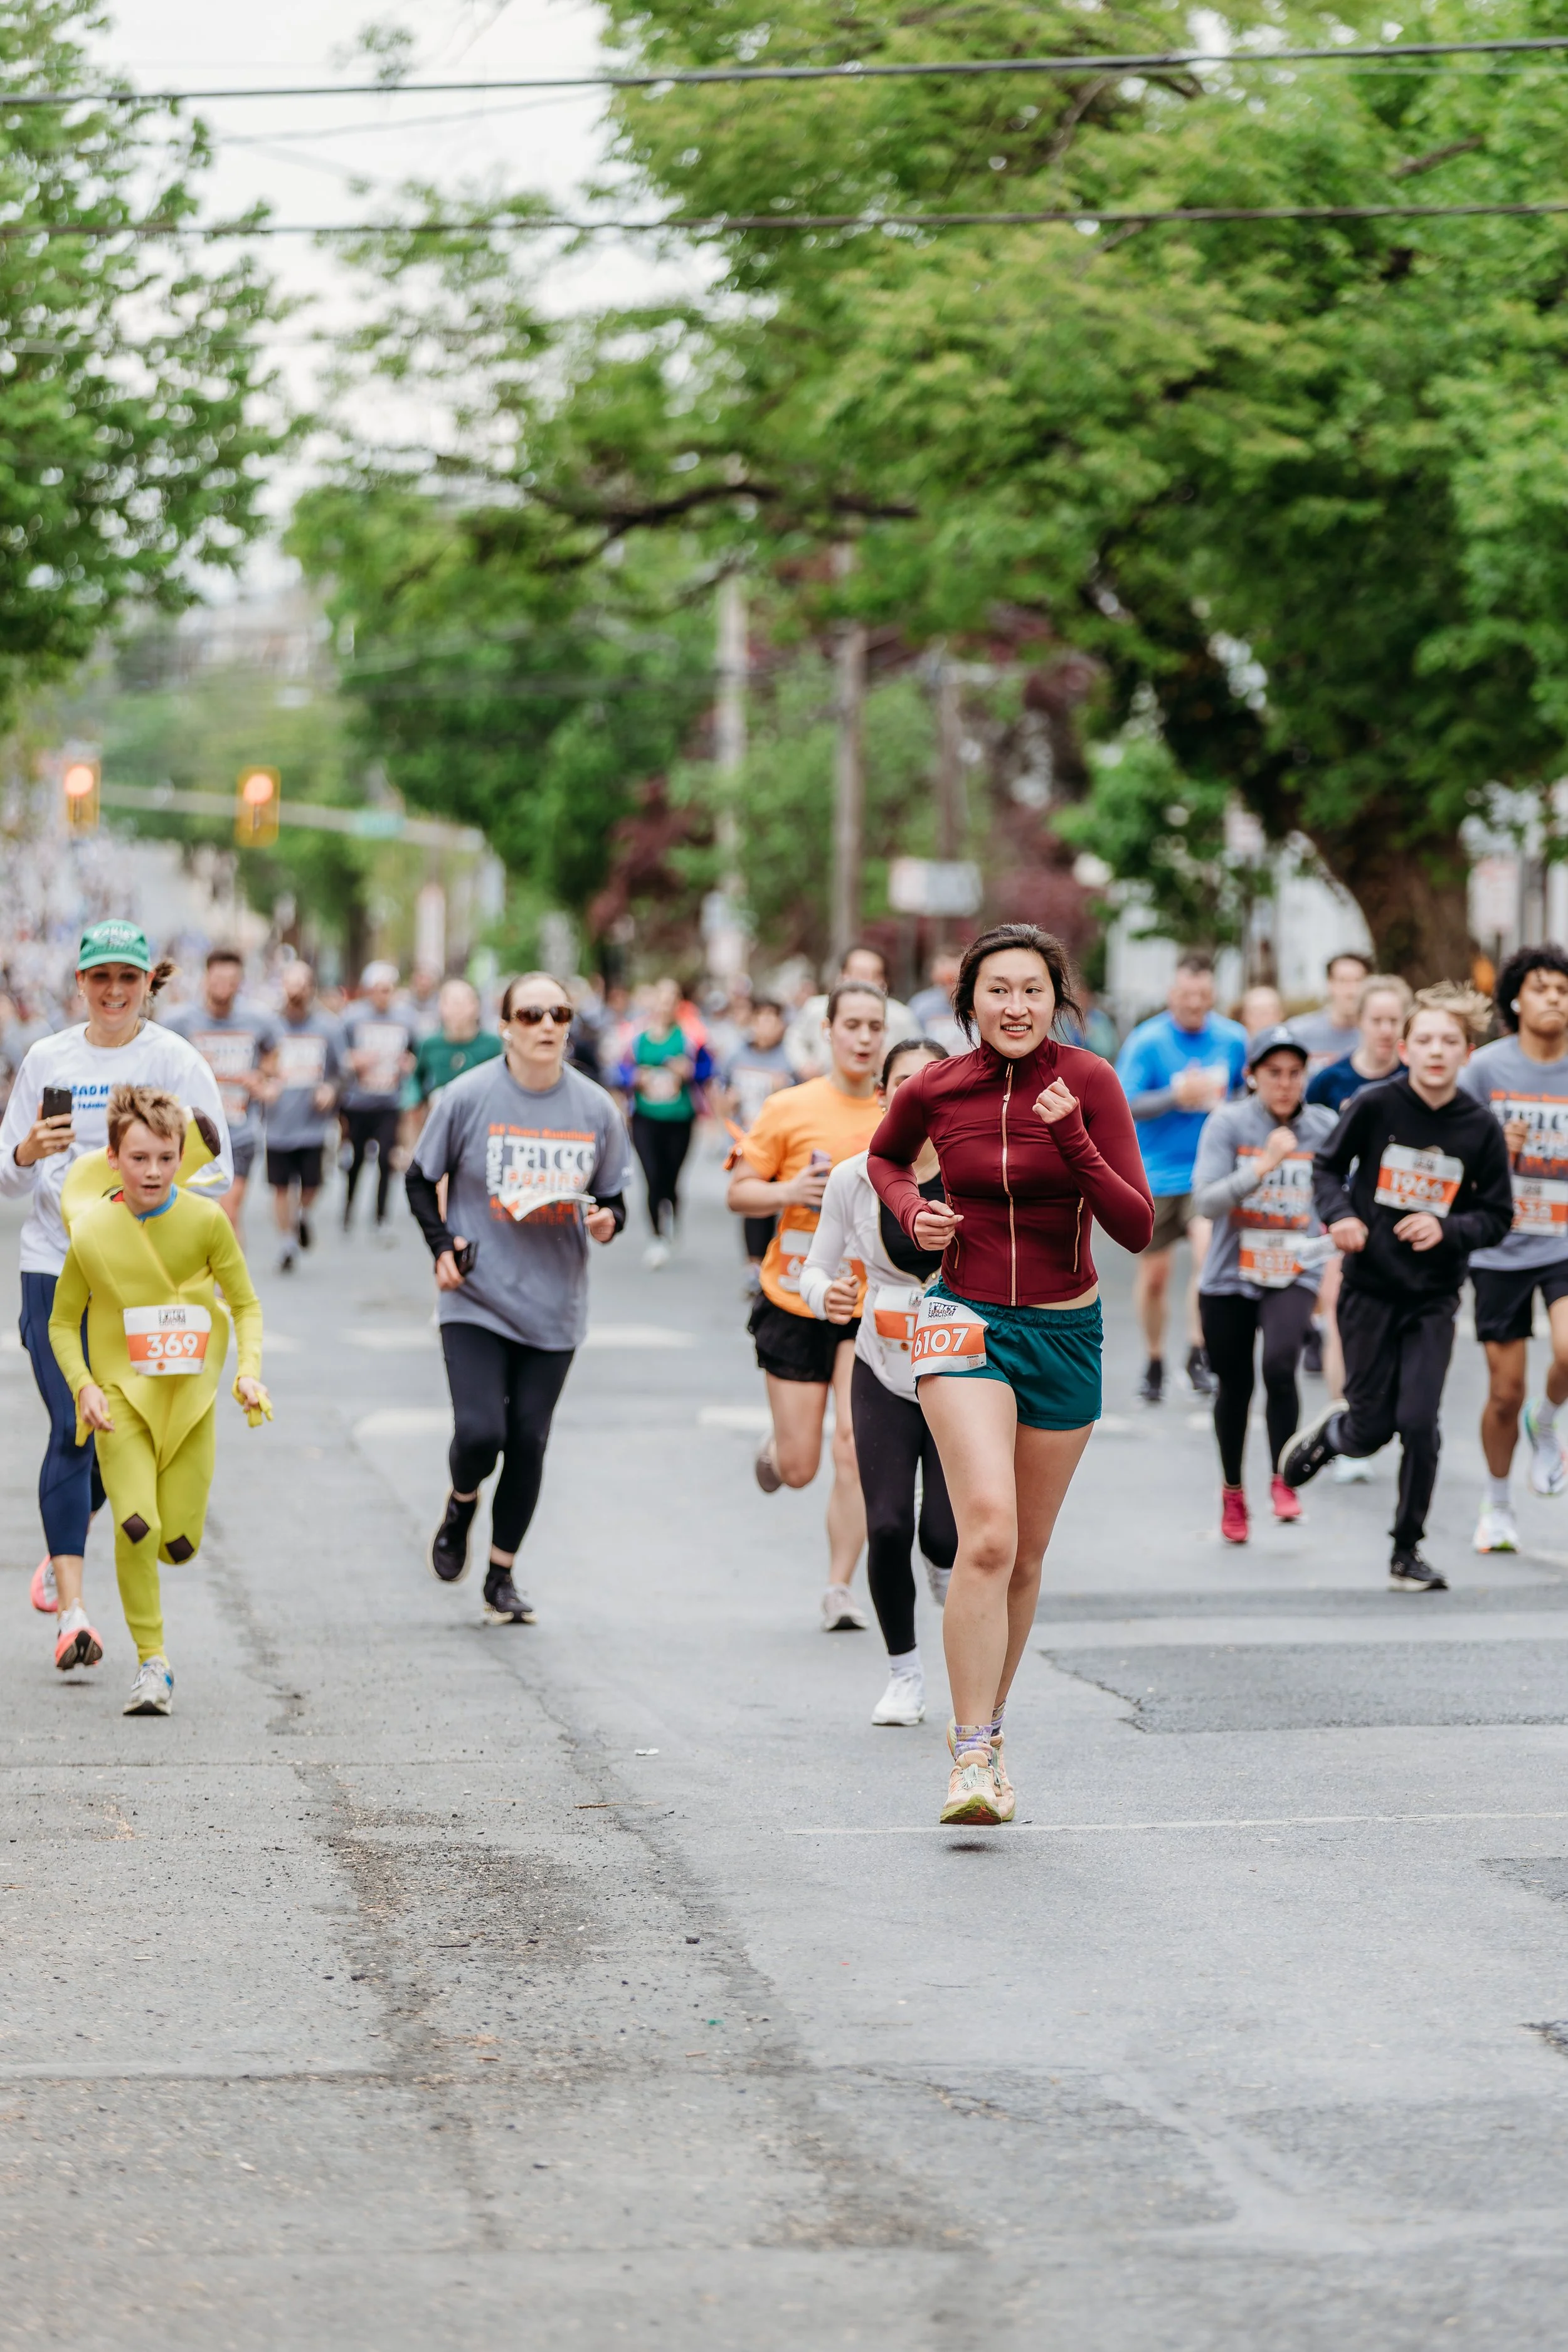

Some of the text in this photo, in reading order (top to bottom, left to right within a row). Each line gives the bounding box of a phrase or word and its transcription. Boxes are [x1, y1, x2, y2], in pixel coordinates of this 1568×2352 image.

[1392, 1171, 1444, 1199] 1966
[146, 1332, 198, 1359] 369
[914, 1327, 970, 1358] 6107
